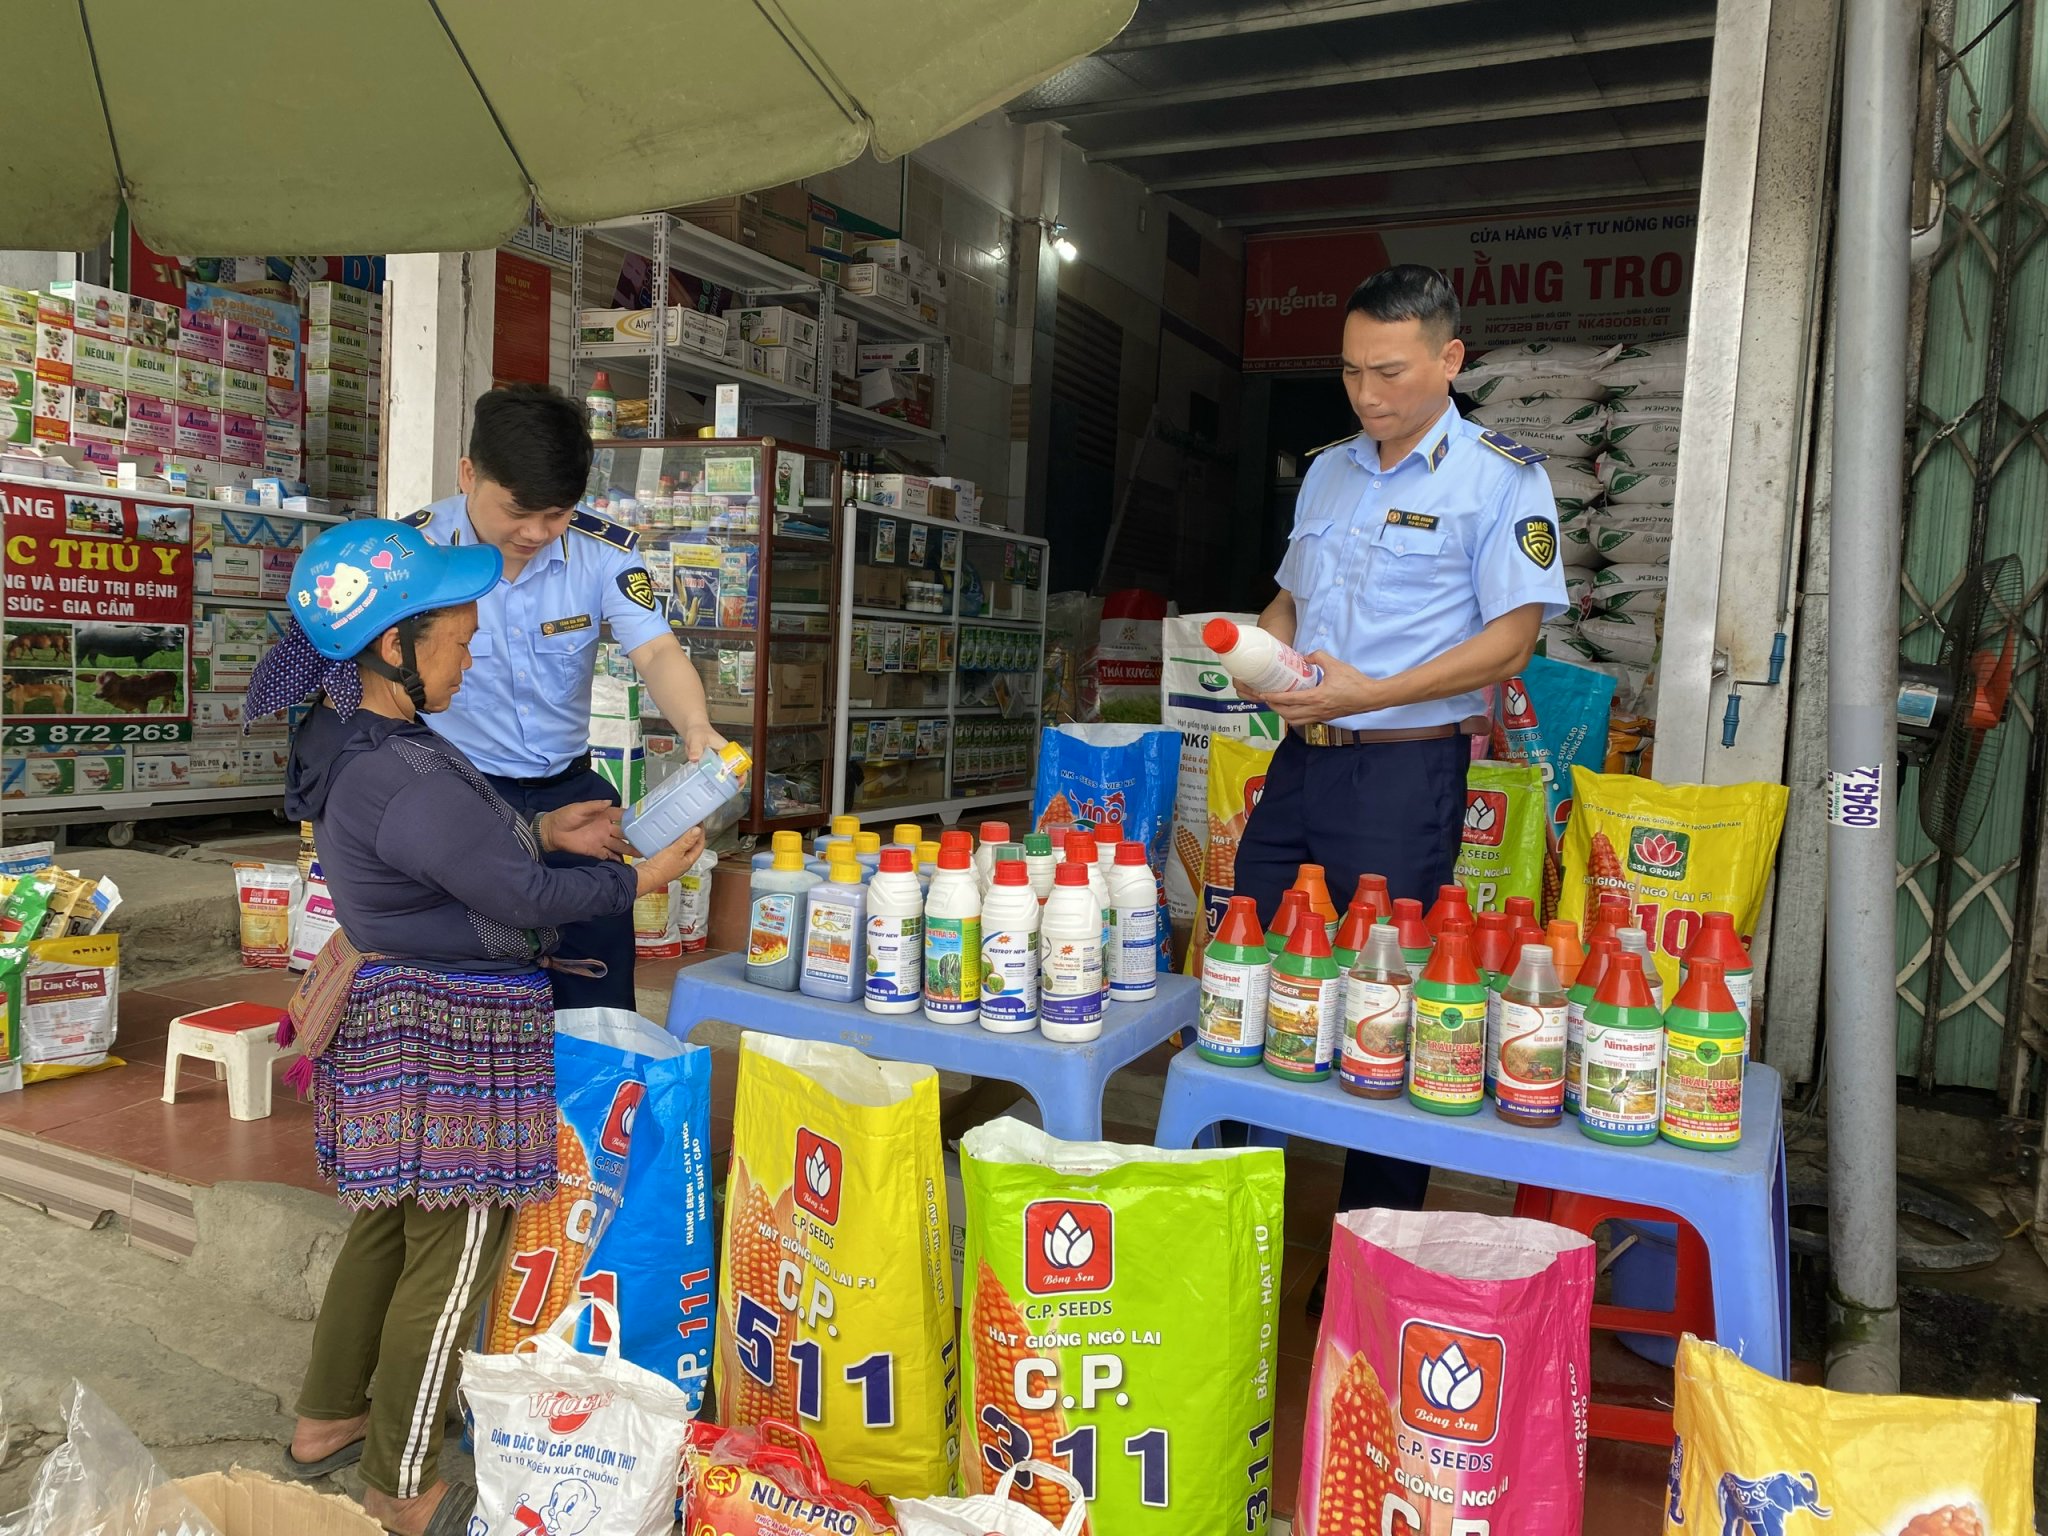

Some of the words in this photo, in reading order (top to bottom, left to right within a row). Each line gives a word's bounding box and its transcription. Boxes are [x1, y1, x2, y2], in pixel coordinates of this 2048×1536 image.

[1470, 226, 1501, 244] CỬA
[1505, 224, 1548, 241] HÀNG
[1552, 221, 1583, 240] VẬT
[1586, 219, 1611, 236] TƯ
[1612, 216, 1658, 234] NÔNG
[1246, 290, 1337, 316] syngenta
[84, 346, 115, 363] NEOLIN
[136, 357, 165, 372] NEOLIN
[232, 377, 258, 392] NEOLIN
[1526, 522, 1548, 532] DMS
[50, 537, 140, 573] THÚ
[152, 547, 181, 576] Y
[31, 574, 55, 592] VÀ
[59, 574, 99, 594] ĐIỀU
[104, 580, 130, 600] TRỊ
[135, 580, 178, 600] BỆNH
[627, 571, 648, 583] DMS
[7, 595, 45, 612] SÚC
[62, 599, 92, 615] GIA
[96, 596, 135, 616] CẦM
[1203, 673, 1219, 684] NK
[1226, 702, 1258, 711] syngenta
[49, 724, 111, 743] 872
[122, 723, 180, 742] 263
[1468, 849, 1500, 860] SEEDS
[1649, 866, 1682, 878] GROUP
[1597, 874, 1636, 892] GIỐNG
[1640, 884, 1668, 898] NGÔ
[1674, 890, 1695, 902] LAI
[1699, 891, 1713, 902] F1
[989, 947, 1012, 955] DESTROY
[1604, 1039, 1656, 1052] Nimasinat
[692, 1138, 702, 1159] CAO
[558, 1172, 583, 1188] HẠT
[695, 1165, 705, 1192] SUẤT
[685, 1180, 694, 1207] BỆNH
[803, 1191, 818, 1209] Bông
[818, 1201, 830, 1216] Sen
[685, 1209, 695, 1246] KHÁNG
[791, 1213, 807, 1232] C.P.
[808, 1223, 835, 1250] SEEDS
[1255, 1224, 1269, 1256] TO
[758, 1222, 779, 1242] HẠT
[781, 1234, 811, 1261] GIỐNG
[832, 1270, 853, 1288] LAI
[857, 1277, 876, 1289] F1
[1042, 1273, 1072, 1286] Bông
[1074, 1272, 1095, 1283] Sen
[1260, 1262, 1275, 1306] HẠT
[678, 1268, 710, 1339] 111
[777, 1258, 838, 1337] C.P.
[1025, 1304, 1055, 1320] C.P.
[1059, 1300, 1113, 1318] SEEDS
[989, 1326, 1019, 1348] HẠT
[1025, 1329, 1081, 1349] GIỐNG
[1088, 1327, 1126, 1346] NGÔ
[1131, 1331, 1162, 1346] LAI
[1259, 1323, 1271, 1353] TO
[736, 1290, 894, 1429] 511
[1013, 1353, 1129, 1411] C.P.
[1250, 1358, 1269, 1401] BẮP
[1568, 1362, 1578, 1396] CAO
[1414, 1408, 1450, 1429] Bông
[1454, 1417, 1480, 1433] Sen
[490, 1428, 510, 1449] ĐẬM
[512, 1432, 535, 1454] ĐẶC
[549, 1438, 572, 1458] CẤP
[574, 1444, 595, 1461] CHO
[595, 1451, 616, 1469] LỢN
[617, 1453, 637, 1475] THỊT
[981, 1403, 1169, 1508] 311
[1397, 1433, 1425, 1461] C.P.
[1430, 1448, 1493, 1472] SEEDS
[515, 1455, 525, 1466] 10
[554, 1463, 582, 1477] XUẤT
[1246, 1418, 1271, 1533] 311
[1365, 1441, 1391, 1473] HẠT
[1394, 1467, 1454, 1505] GIỐNG
[1461, 1487, 1498, 1508] NGÔ
[749, 1479, 858, 1536] NUTI-PRO
